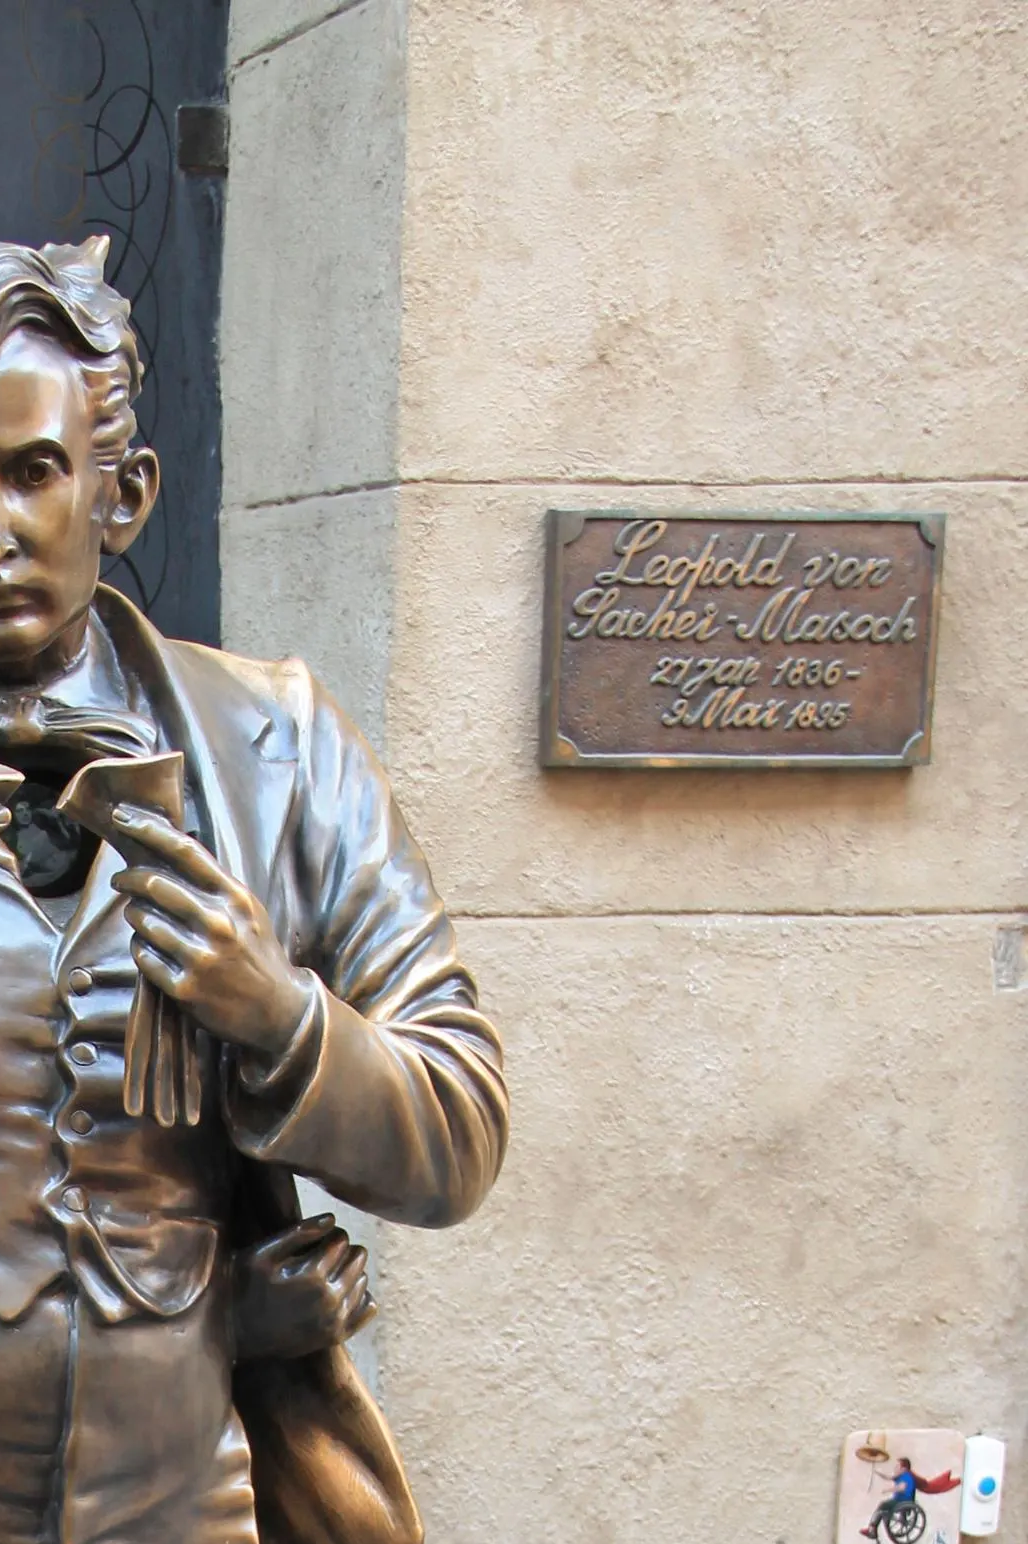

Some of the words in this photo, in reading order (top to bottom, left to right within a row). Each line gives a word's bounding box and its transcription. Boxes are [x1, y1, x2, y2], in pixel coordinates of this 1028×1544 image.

[594, 519, 797, 607] Leopold
[803, 551, 893, 588] von
[784, 699, 852, 730] 1895
